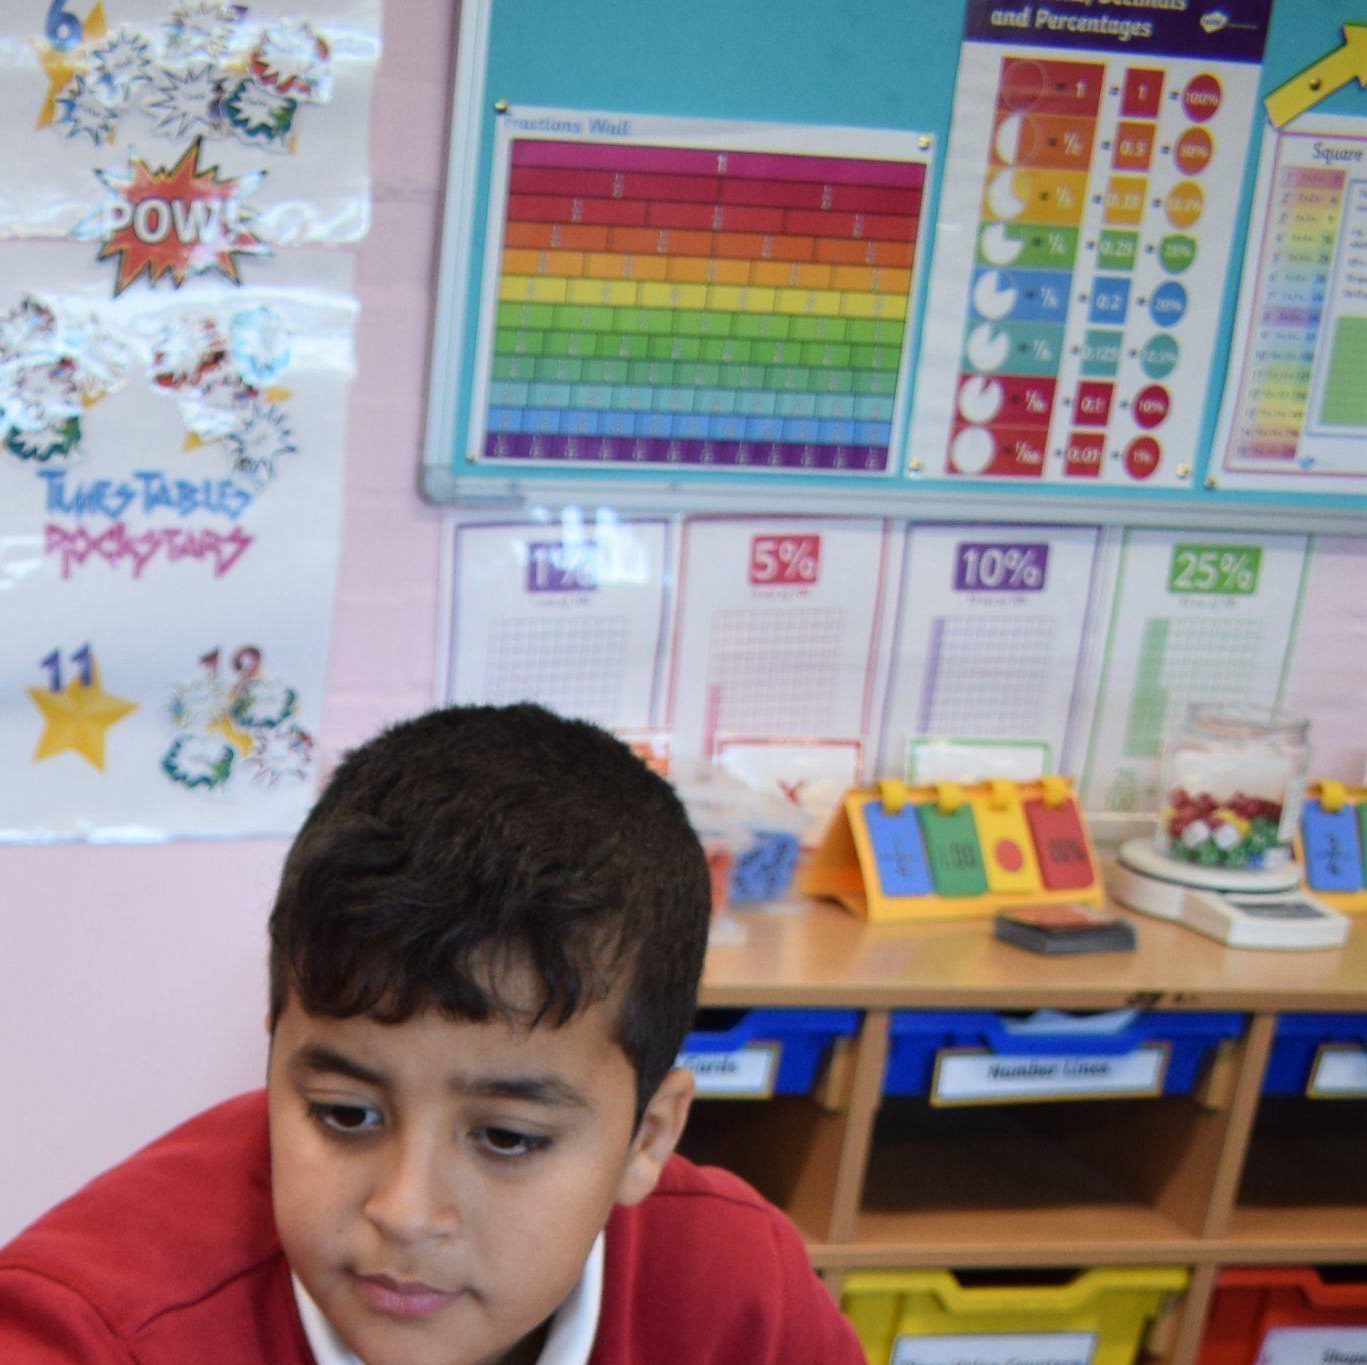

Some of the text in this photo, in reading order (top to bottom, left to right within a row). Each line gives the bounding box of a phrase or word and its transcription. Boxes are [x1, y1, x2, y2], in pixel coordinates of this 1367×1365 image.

[45, 0, 83, 49] 6
[991, 7, 1153, 41] and Percentages
[1313, 142, 1363, 164] Square
[753, 541, 815, 582] 5%
[961, 549, 1042, 589] 10%
[1173, 550, 1254, 591] 25%
[40, 642, 93, 692] 11
[987, 1059, 1111, 1081] Number Lines
